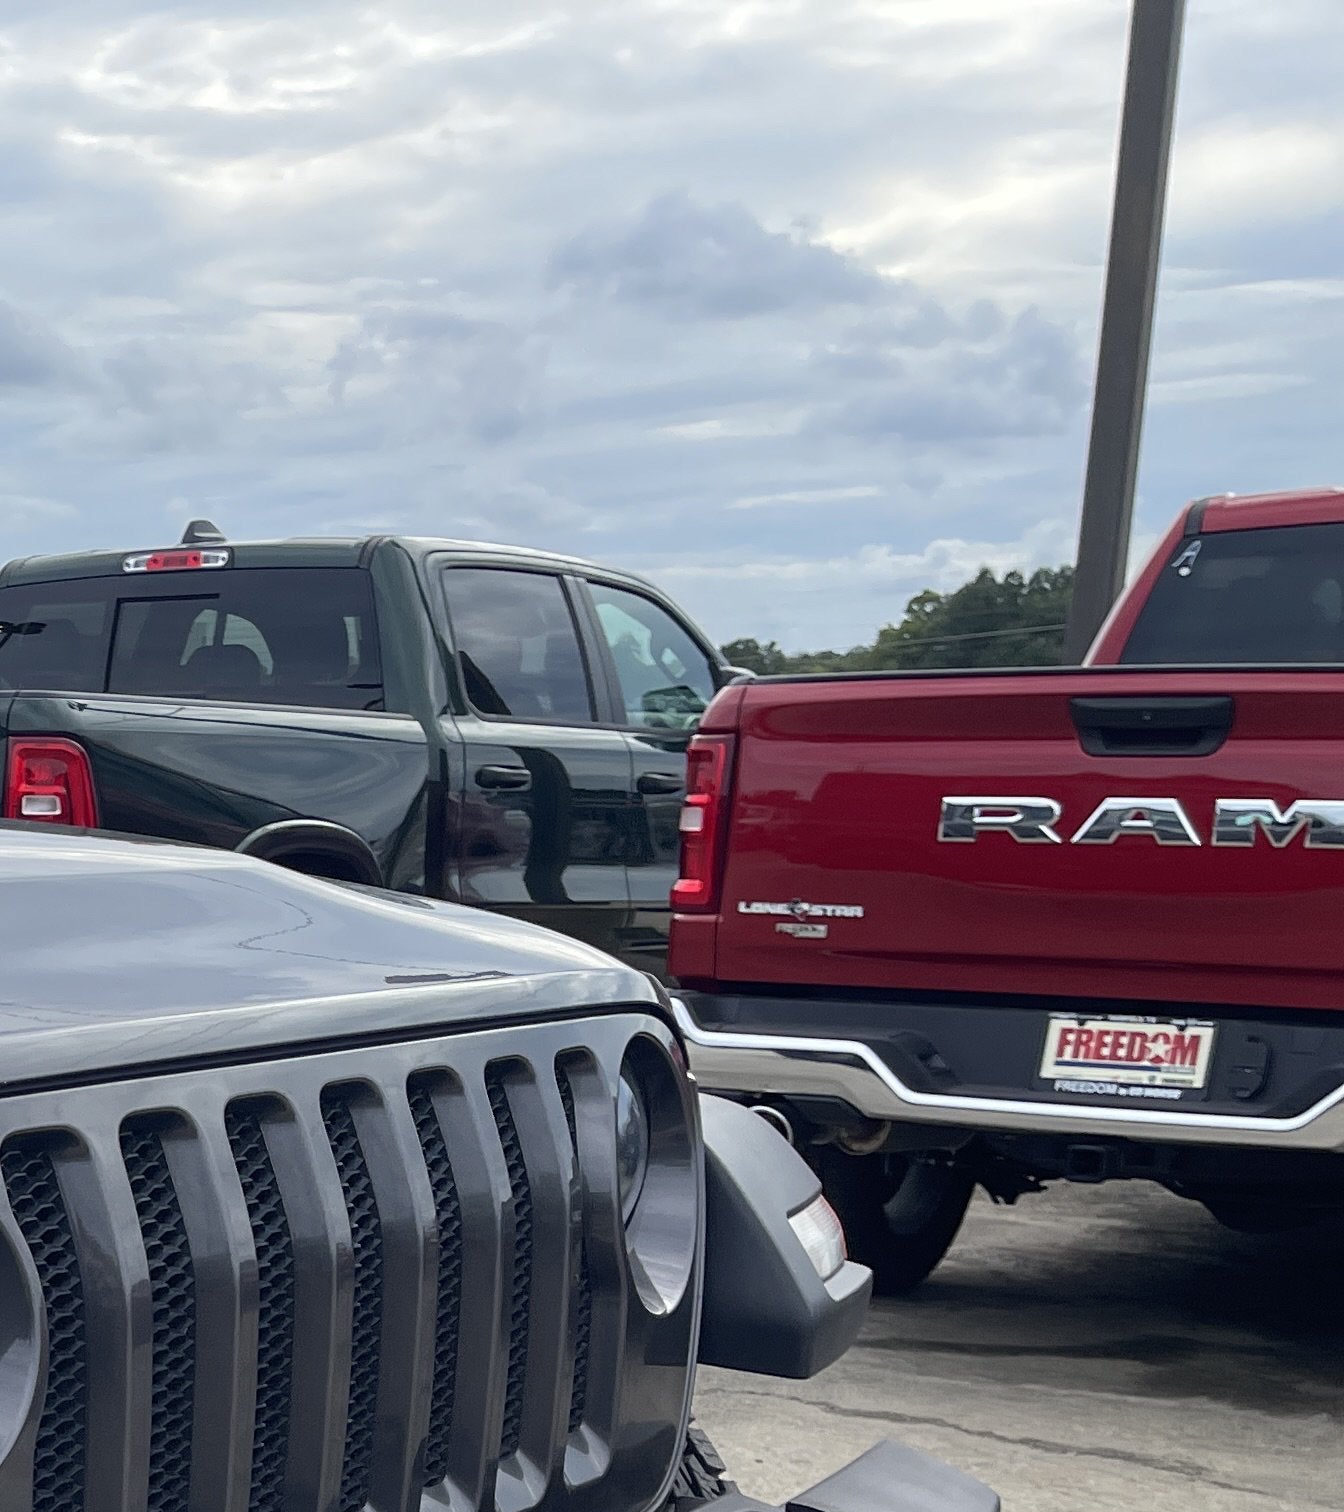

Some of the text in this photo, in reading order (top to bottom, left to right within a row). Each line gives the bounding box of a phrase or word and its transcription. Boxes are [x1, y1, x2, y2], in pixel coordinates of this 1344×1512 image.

[937, 796, 1344, 849] RAM
[809, 904, 865, 918] STAR
[1055, 1028, 1202, 1067] FREEDOM
